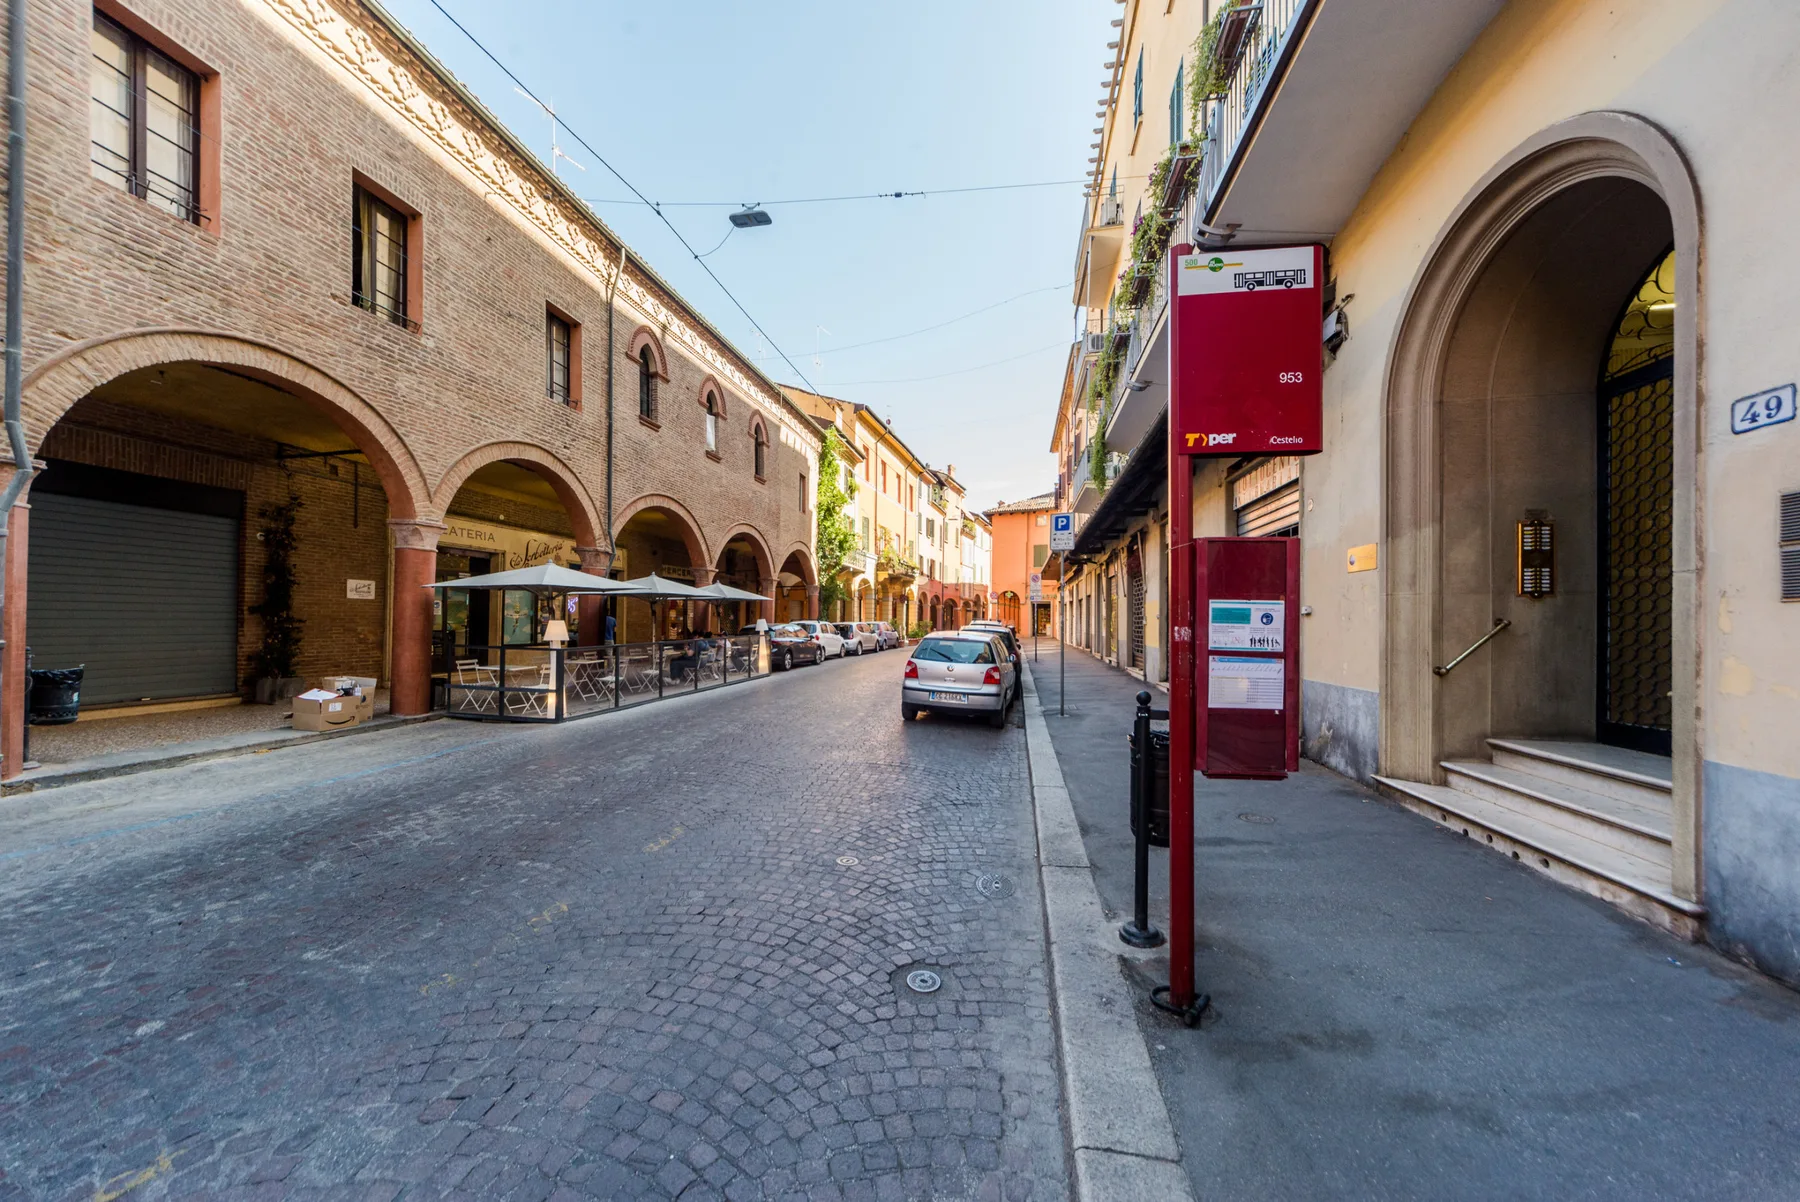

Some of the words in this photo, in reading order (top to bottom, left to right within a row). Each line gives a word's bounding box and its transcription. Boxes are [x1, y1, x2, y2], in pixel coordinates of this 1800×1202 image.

[1184, 258, 1199, 267] 500
[1279, 371, 1303, 384] 953
[1739, 394, 1783, 425] 49
[1058, 517, 1067, 529] P
[443, 526, 496, 543] ATERIA
